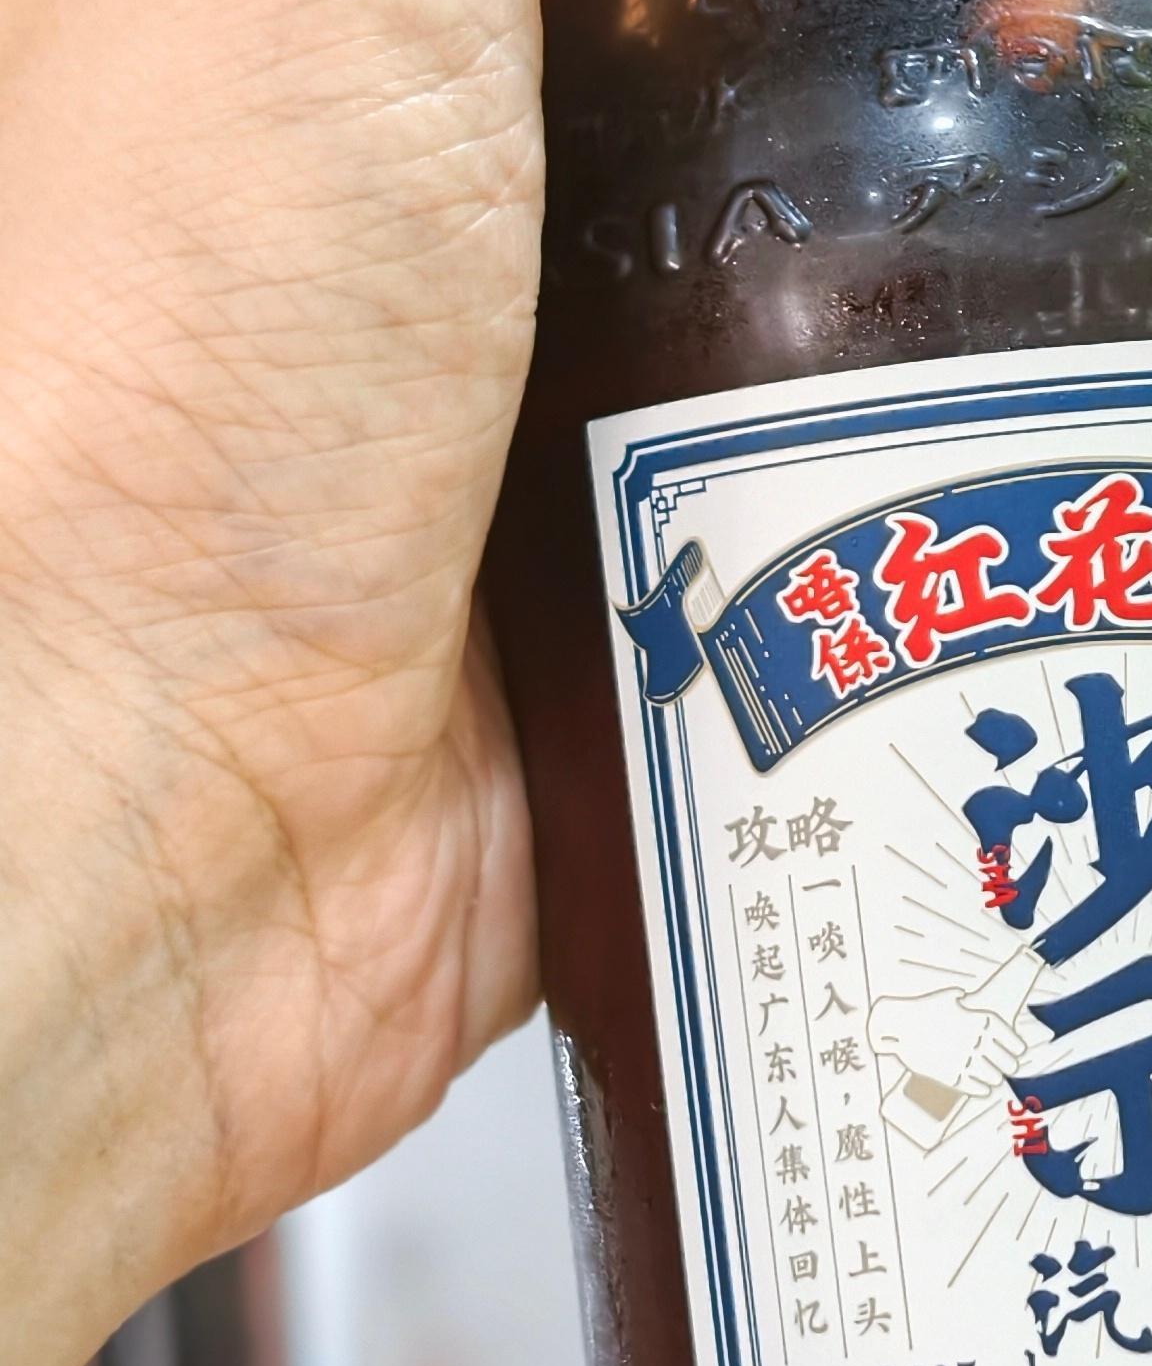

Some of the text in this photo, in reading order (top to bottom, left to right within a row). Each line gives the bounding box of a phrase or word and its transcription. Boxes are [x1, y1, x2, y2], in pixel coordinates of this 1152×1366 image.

[725, 796, 853, 869] 攻略
[744, 890, 829, 1337] 唤起广东人集体回忆
